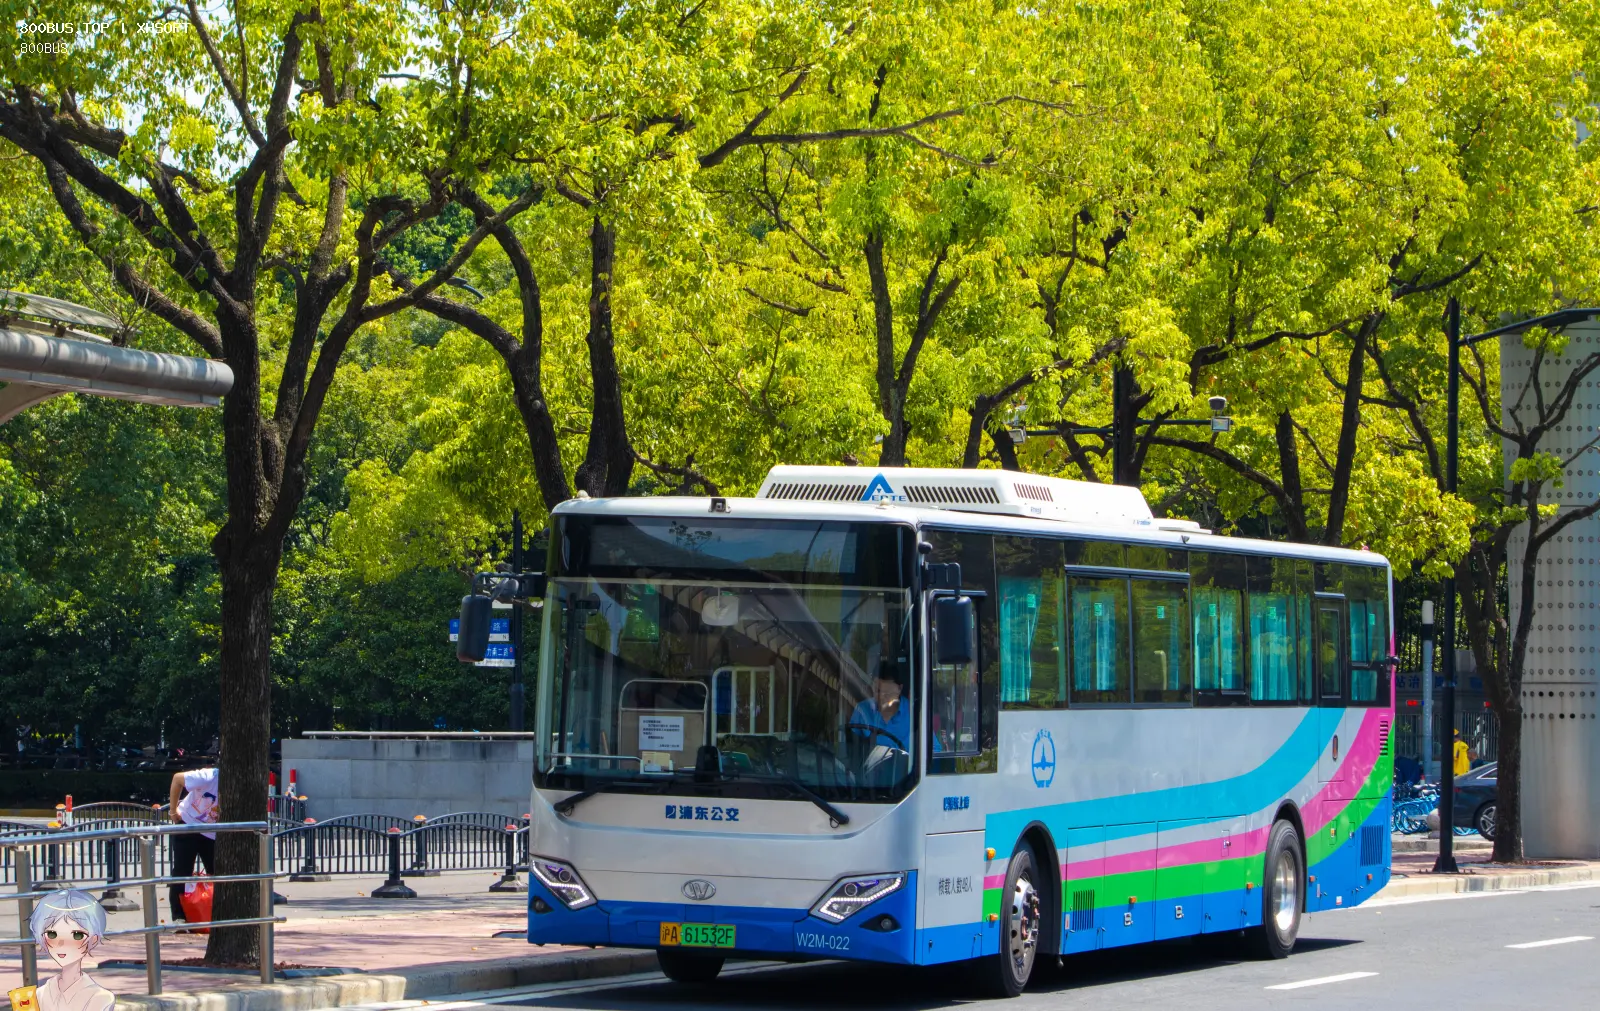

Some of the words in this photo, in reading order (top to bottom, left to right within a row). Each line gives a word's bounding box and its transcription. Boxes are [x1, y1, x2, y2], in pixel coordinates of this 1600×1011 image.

[679, 805, 739, 821] 浦东公交
[796, 932, 850, 950] W2M-022
